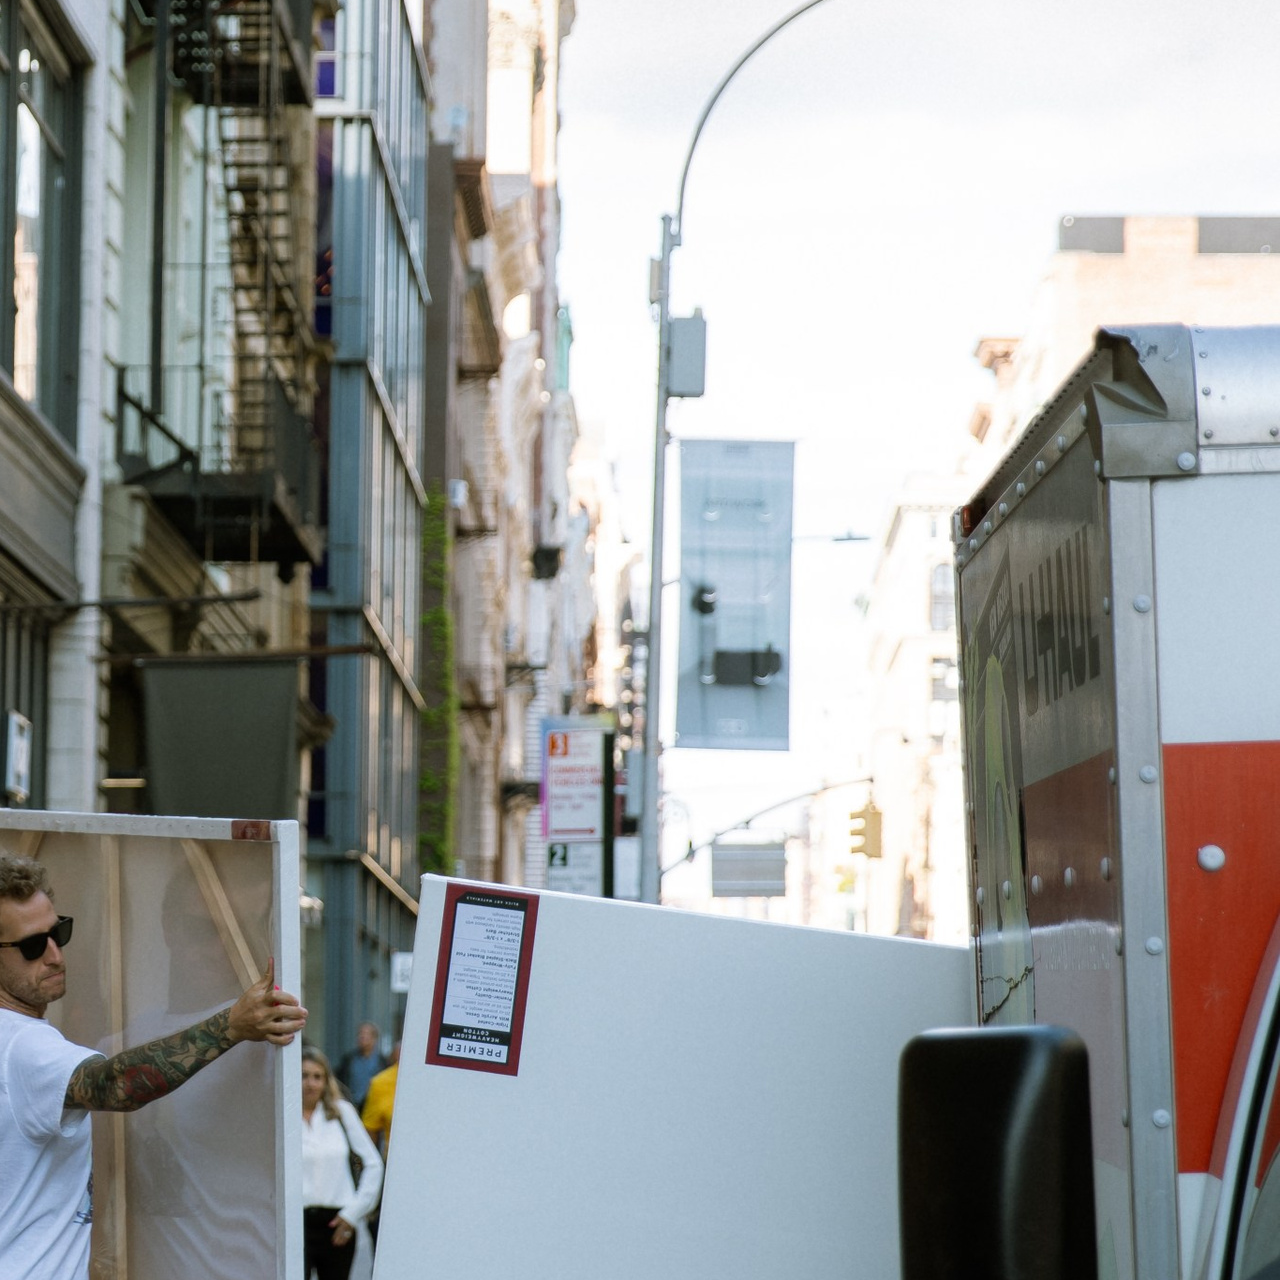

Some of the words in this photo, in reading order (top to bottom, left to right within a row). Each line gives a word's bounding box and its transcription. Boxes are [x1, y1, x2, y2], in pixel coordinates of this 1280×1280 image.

[485, 955, 516, 963] Back-Stapled
[475, 992, 511, 1000] Premier-Quality
[477, 1019, 508, 1027] Triple-Coated
[451, 1032, 499, 1042] HEAVYWEIGHT
[446, 1043, 501, 1057] PREMIER
